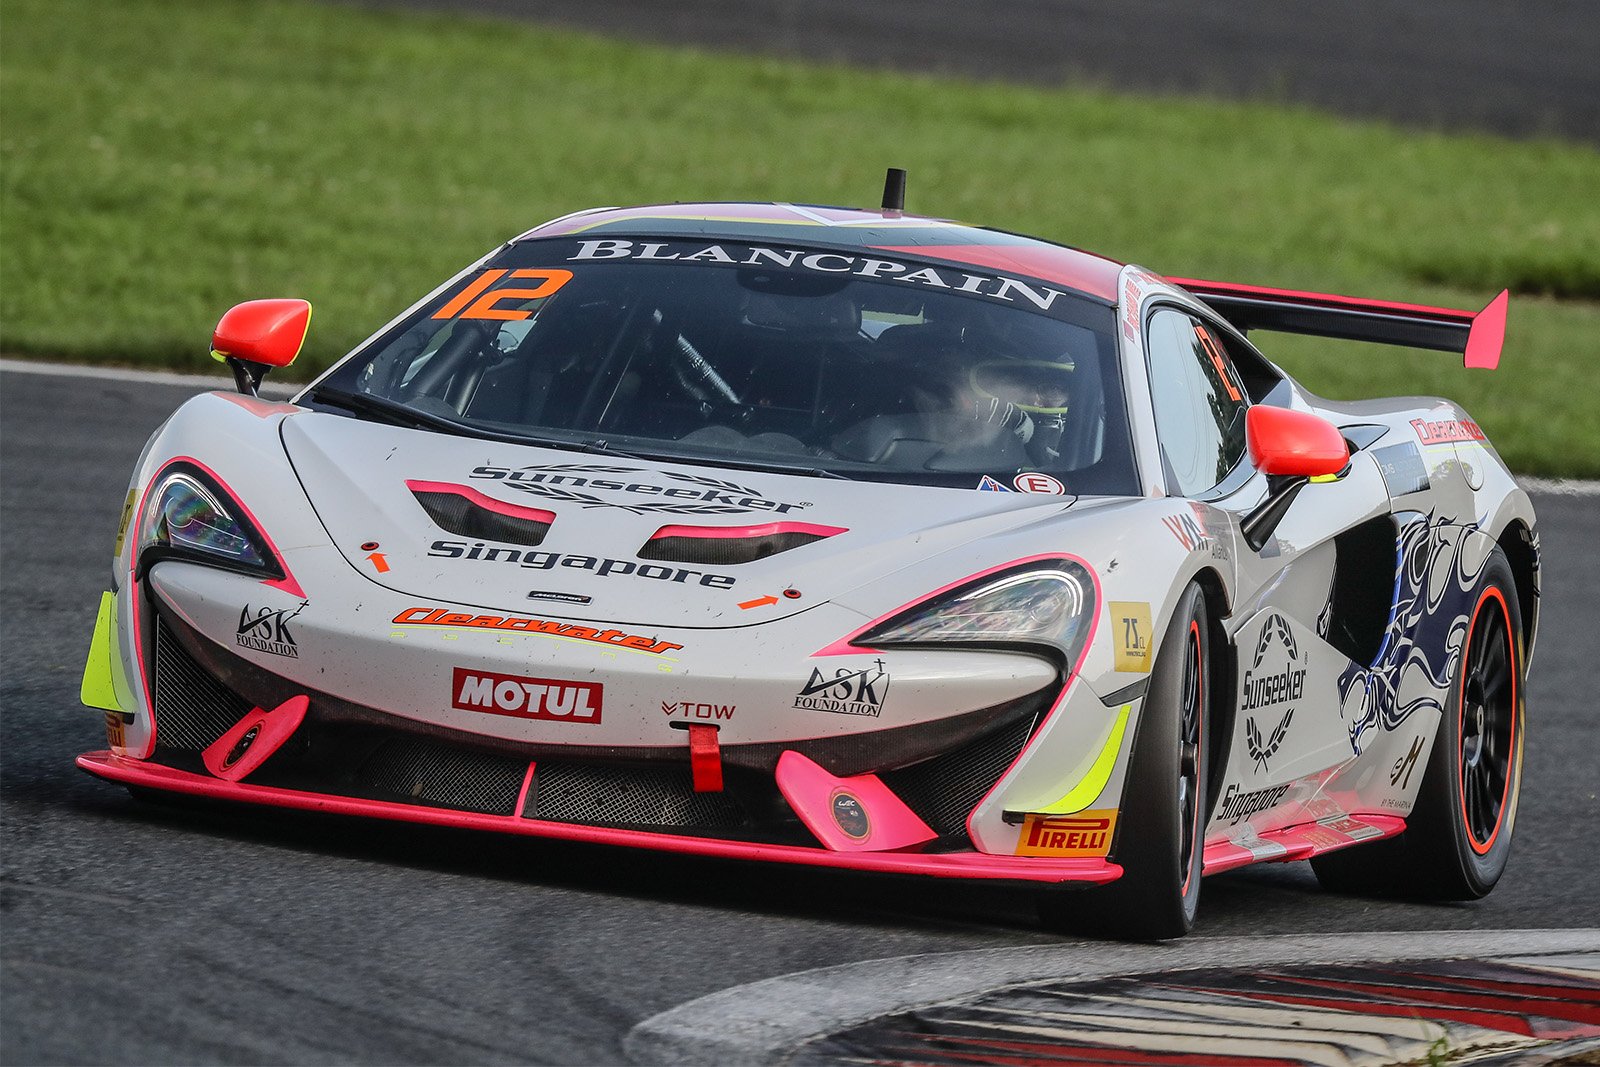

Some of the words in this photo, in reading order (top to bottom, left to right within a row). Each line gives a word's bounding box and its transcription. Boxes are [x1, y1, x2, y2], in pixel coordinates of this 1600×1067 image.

[431, 268, 574, 321] 12
[567, 239, 1066, 310] BLANCPAIN
[427, 539, 737, 590] Singapore
[236, 602, 302, 645] ASK
[236, 633, 299, 657] FOUNDATION
[392, 607, 684, 653] Clearwater
[458, 674, 595, 718] MOTUL
[794, 695, 879, 716] FOUNDATION
[800, 666, 884, 705] ASK
[680, 702, 736, 720] TOW
[1215, 783, 1288, 826] Singapore
[1027, 818, 1110, 848] PIRELLI
